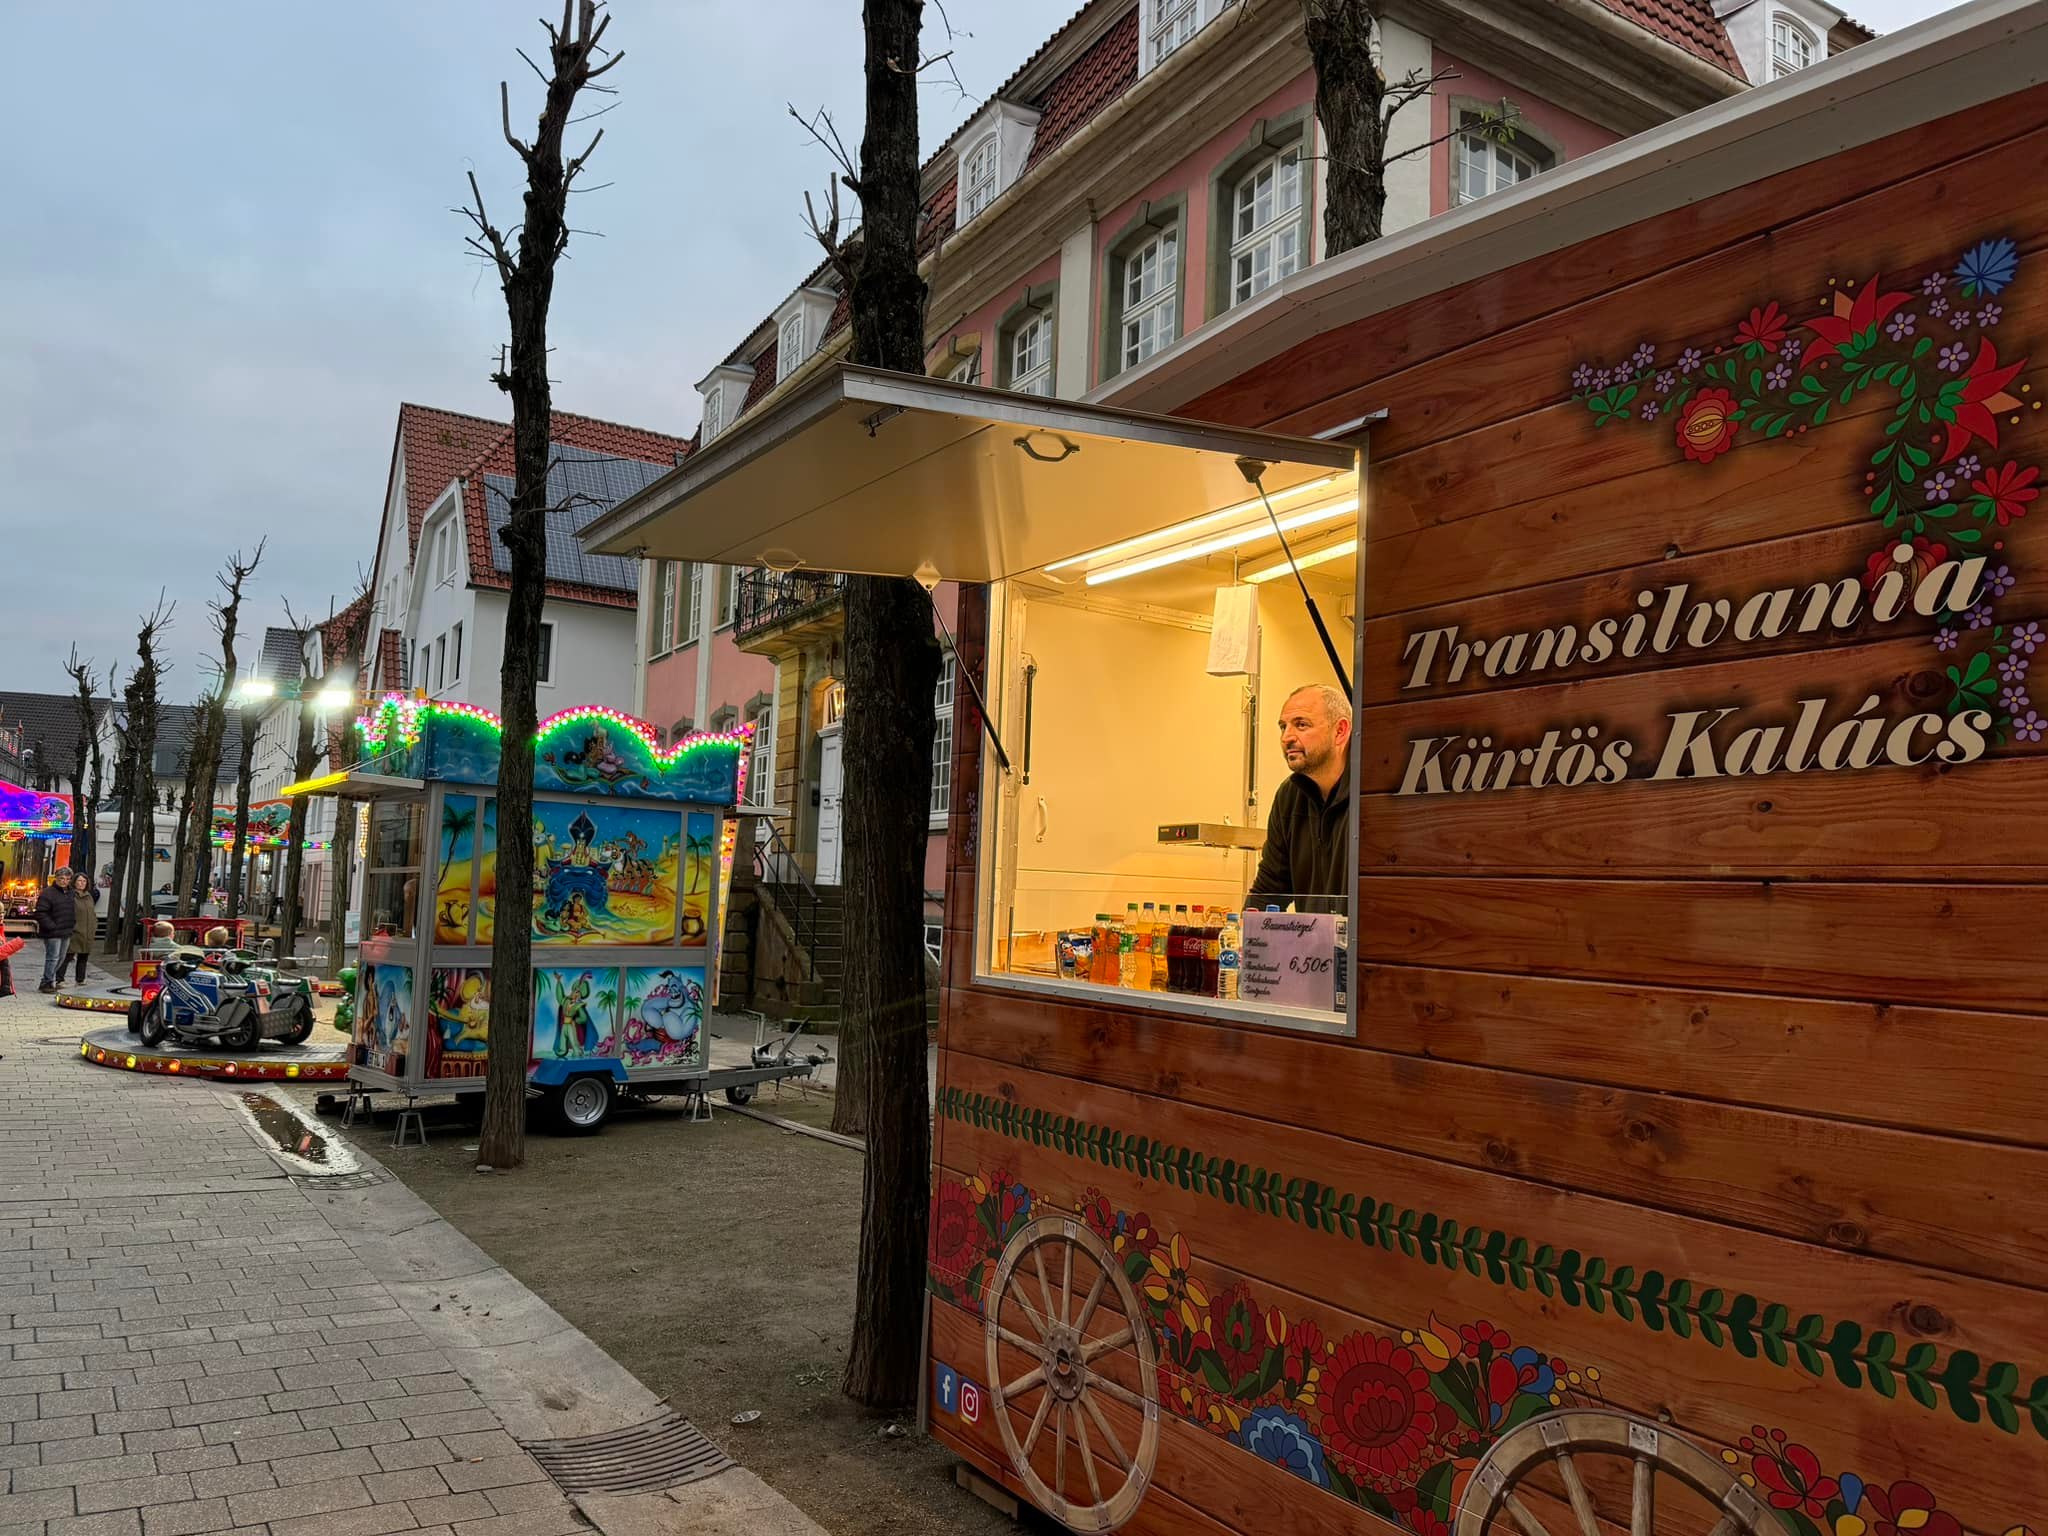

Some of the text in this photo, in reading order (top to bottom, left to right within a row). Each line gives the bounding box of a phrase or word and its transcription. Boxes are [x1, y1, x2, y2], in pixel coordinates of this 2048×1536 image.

[1401, 543, 1988, 690] Transilvania
[1396, 694, 1992, 796] Kürtös Kalács
[1289, 956, 1332, 974] 6,50€
